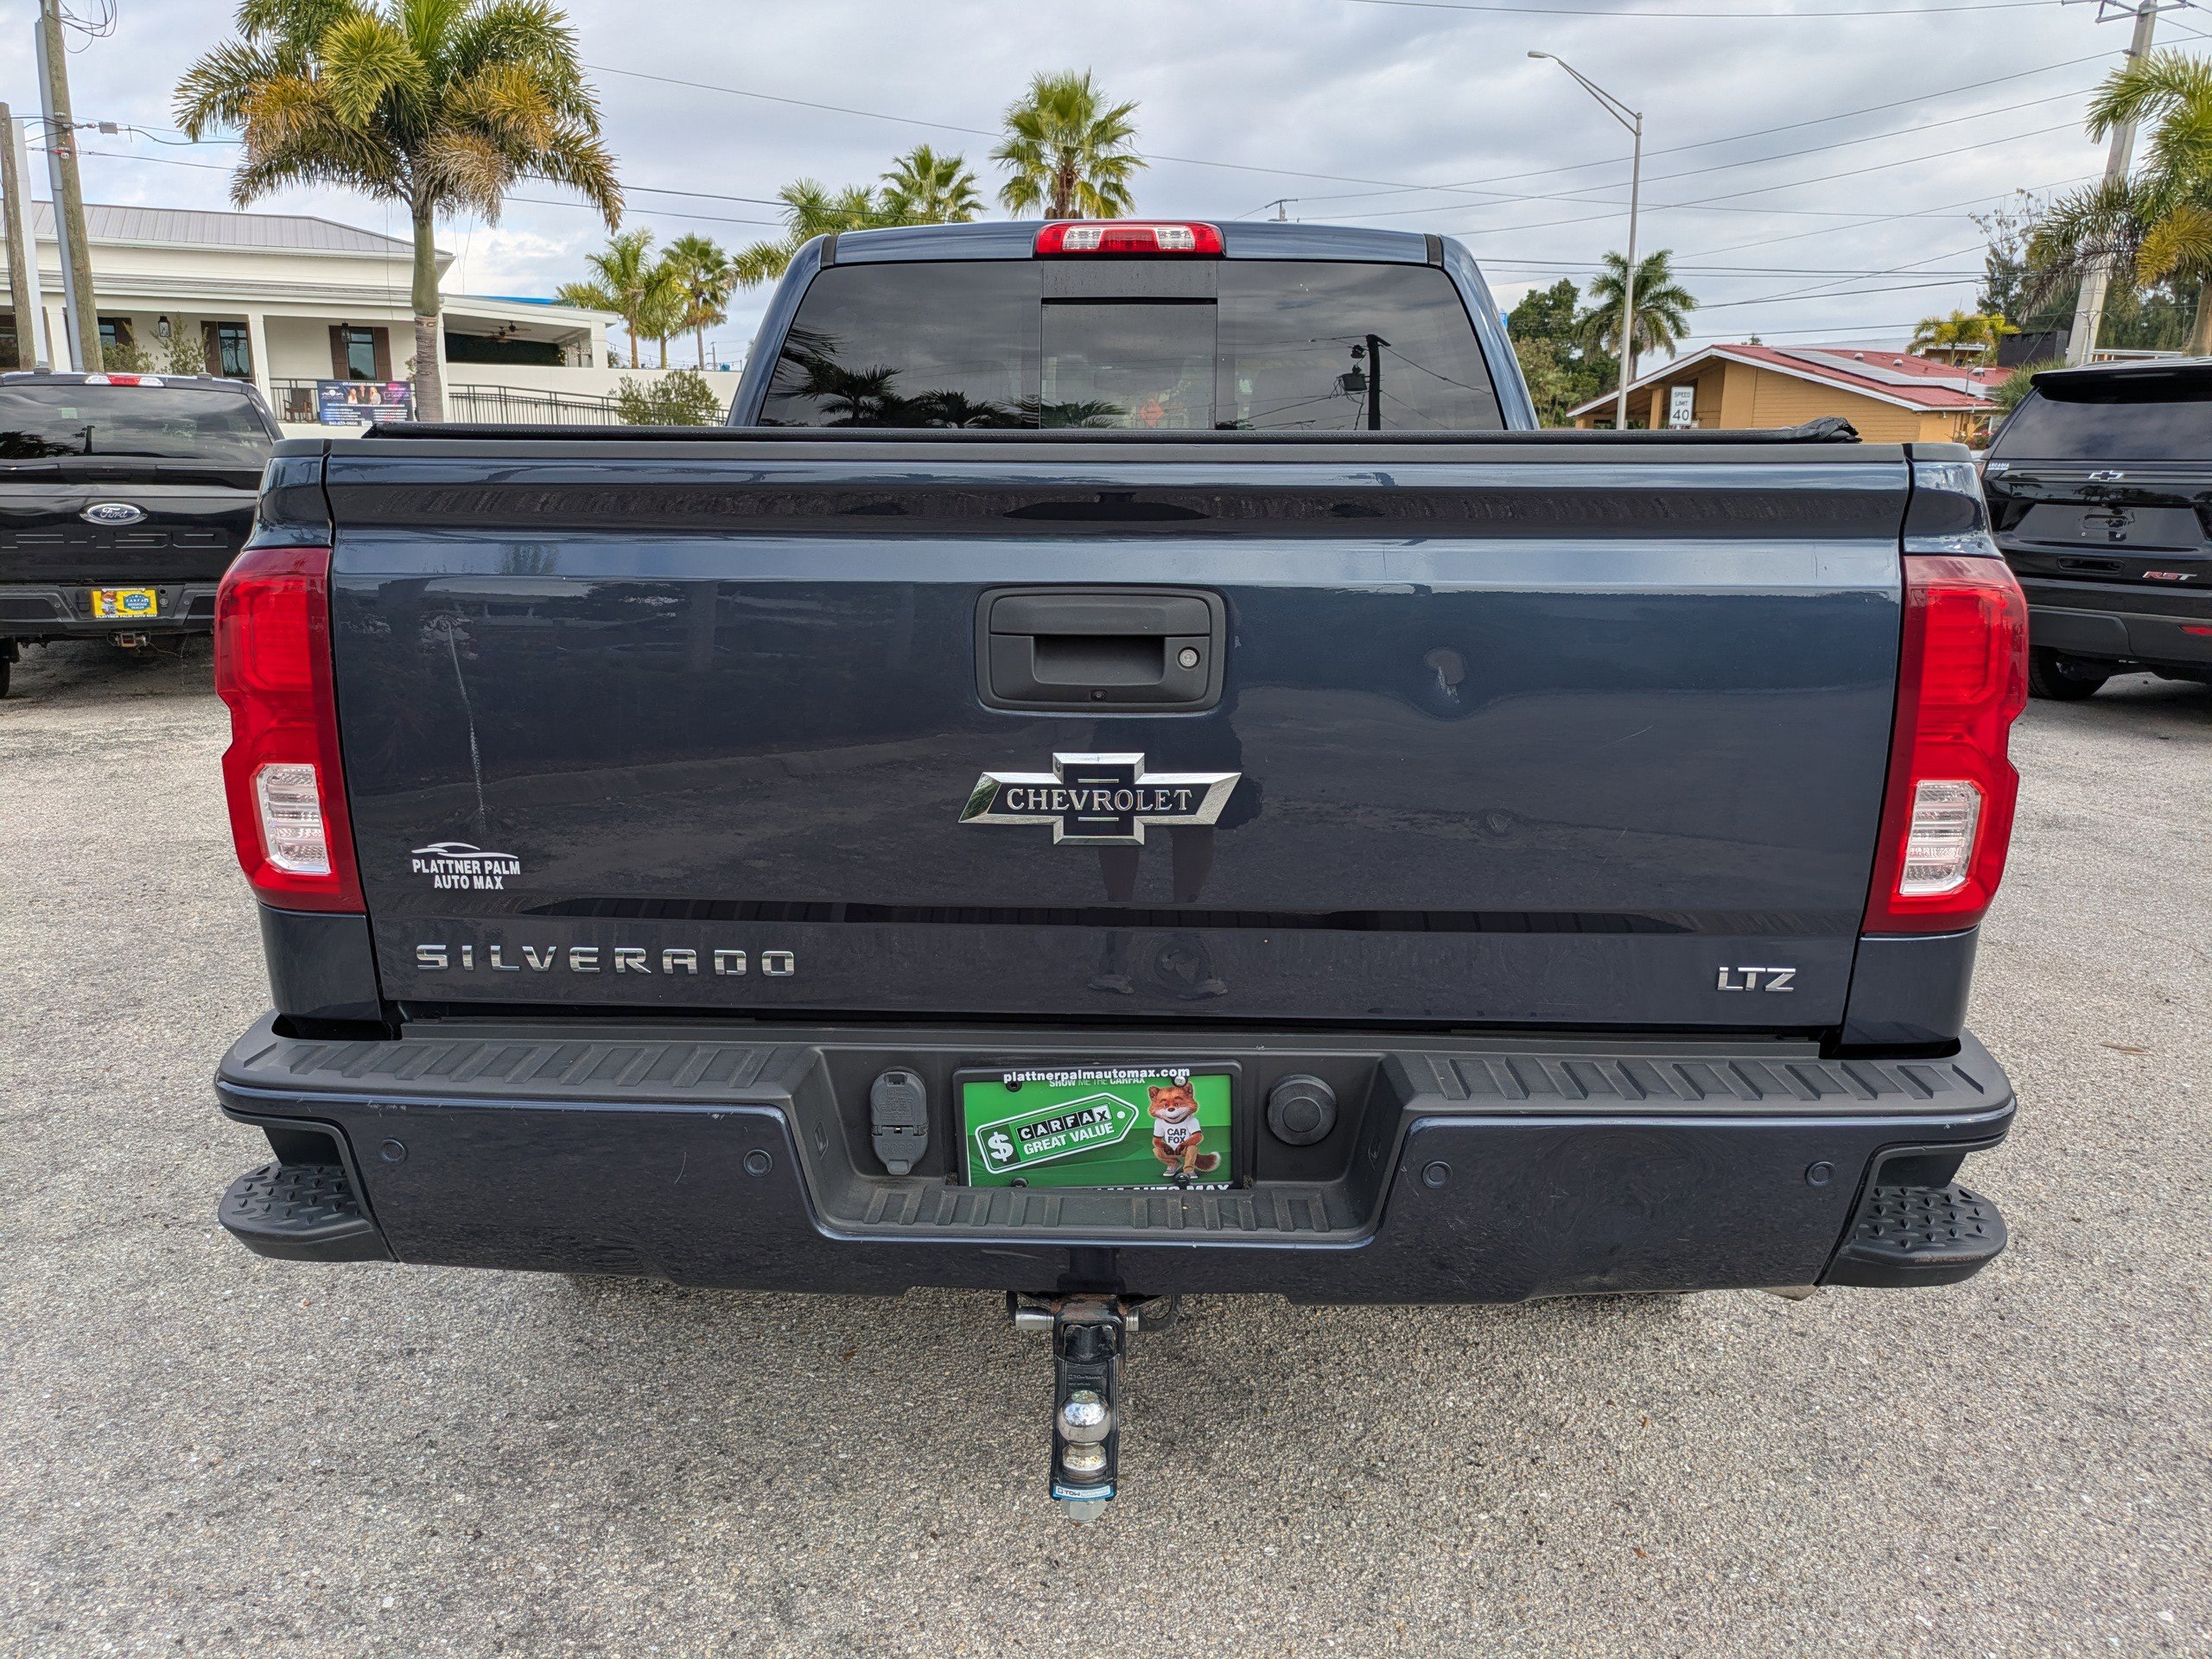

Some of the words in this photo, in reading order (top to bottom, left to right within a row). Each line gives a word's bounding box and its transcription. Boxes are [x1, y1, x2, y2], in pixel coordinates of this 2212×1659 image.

[1672, 410, 1689, 421] 40
[99, 506, 128, 518] Ford
[2142, 570, 2197, 581] RST
[1007, 788, 1192, 811] CHEVROLET
[412, 859, 481, 874] PLATTNER
[484, 861, 521, 875] PALM
[434, 874, 470, 889] AUTO
[473, 875, 504, 890] MAX
[416, 944, 795, 977] SILVERADO
[1717, 967, 1796, 992] LTZ
[1003, 1067, 1191, 1083] plattnerpalmautomax.com
[1020, 1109, 1109, 1141] CARFAX
[1166, 1128, 1187, 1136] CAR
[1023, 1134, 1066, 1155] GREAT
[1070, 1122, 1115, 1143] VALUE
[1167, 1135, 1186, 1144] FOX
